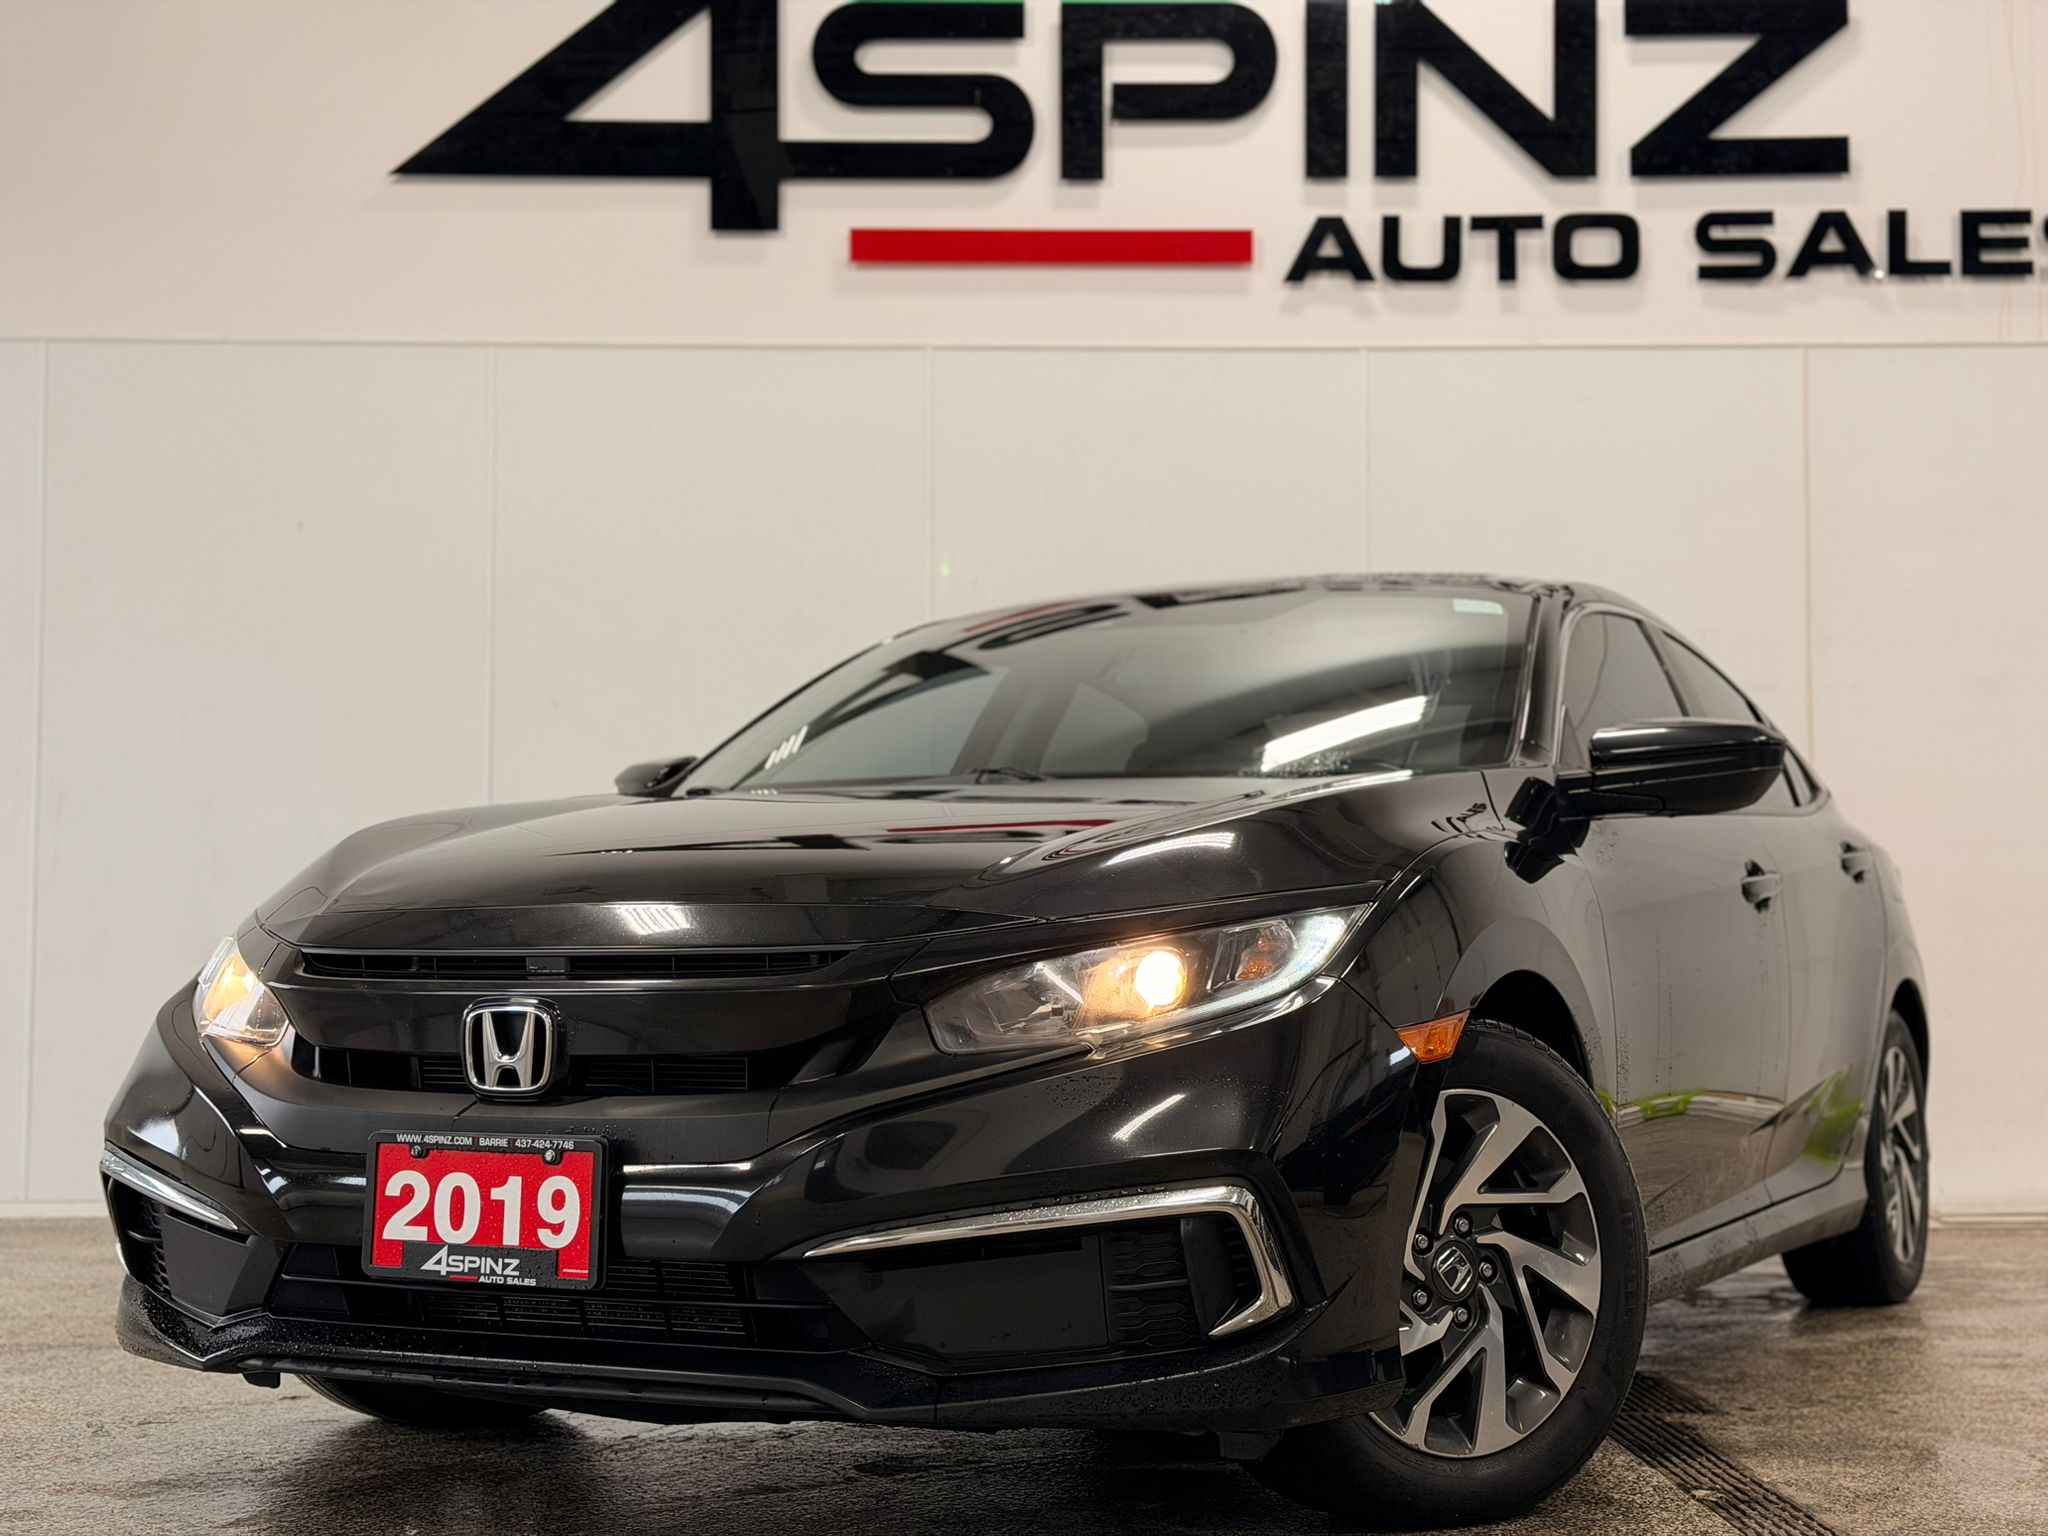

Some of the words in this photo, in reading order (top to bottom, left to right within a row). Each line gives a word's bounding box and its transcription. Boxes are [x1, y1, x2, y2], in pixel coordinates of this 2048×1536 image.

[387, 0, 1849, 231] 4SPINZ
[1285, 213, 1640, 283] AUTO
[1696, 210, 2048, 281] SALE
[396, 1133, 473, 1146] WWW.4SPINZ.COM
[479, 1137, 509, 1148] BARRIE
[514, 1138, 575, 1150] 437-424-7746
[382, 1170, 581, 1249] 2019
[420, 1244, 520, 1276] 4SPINZ
[478, 1275, 504, 1285] AUTO
[506, 1276, 537, 1287] SALES
